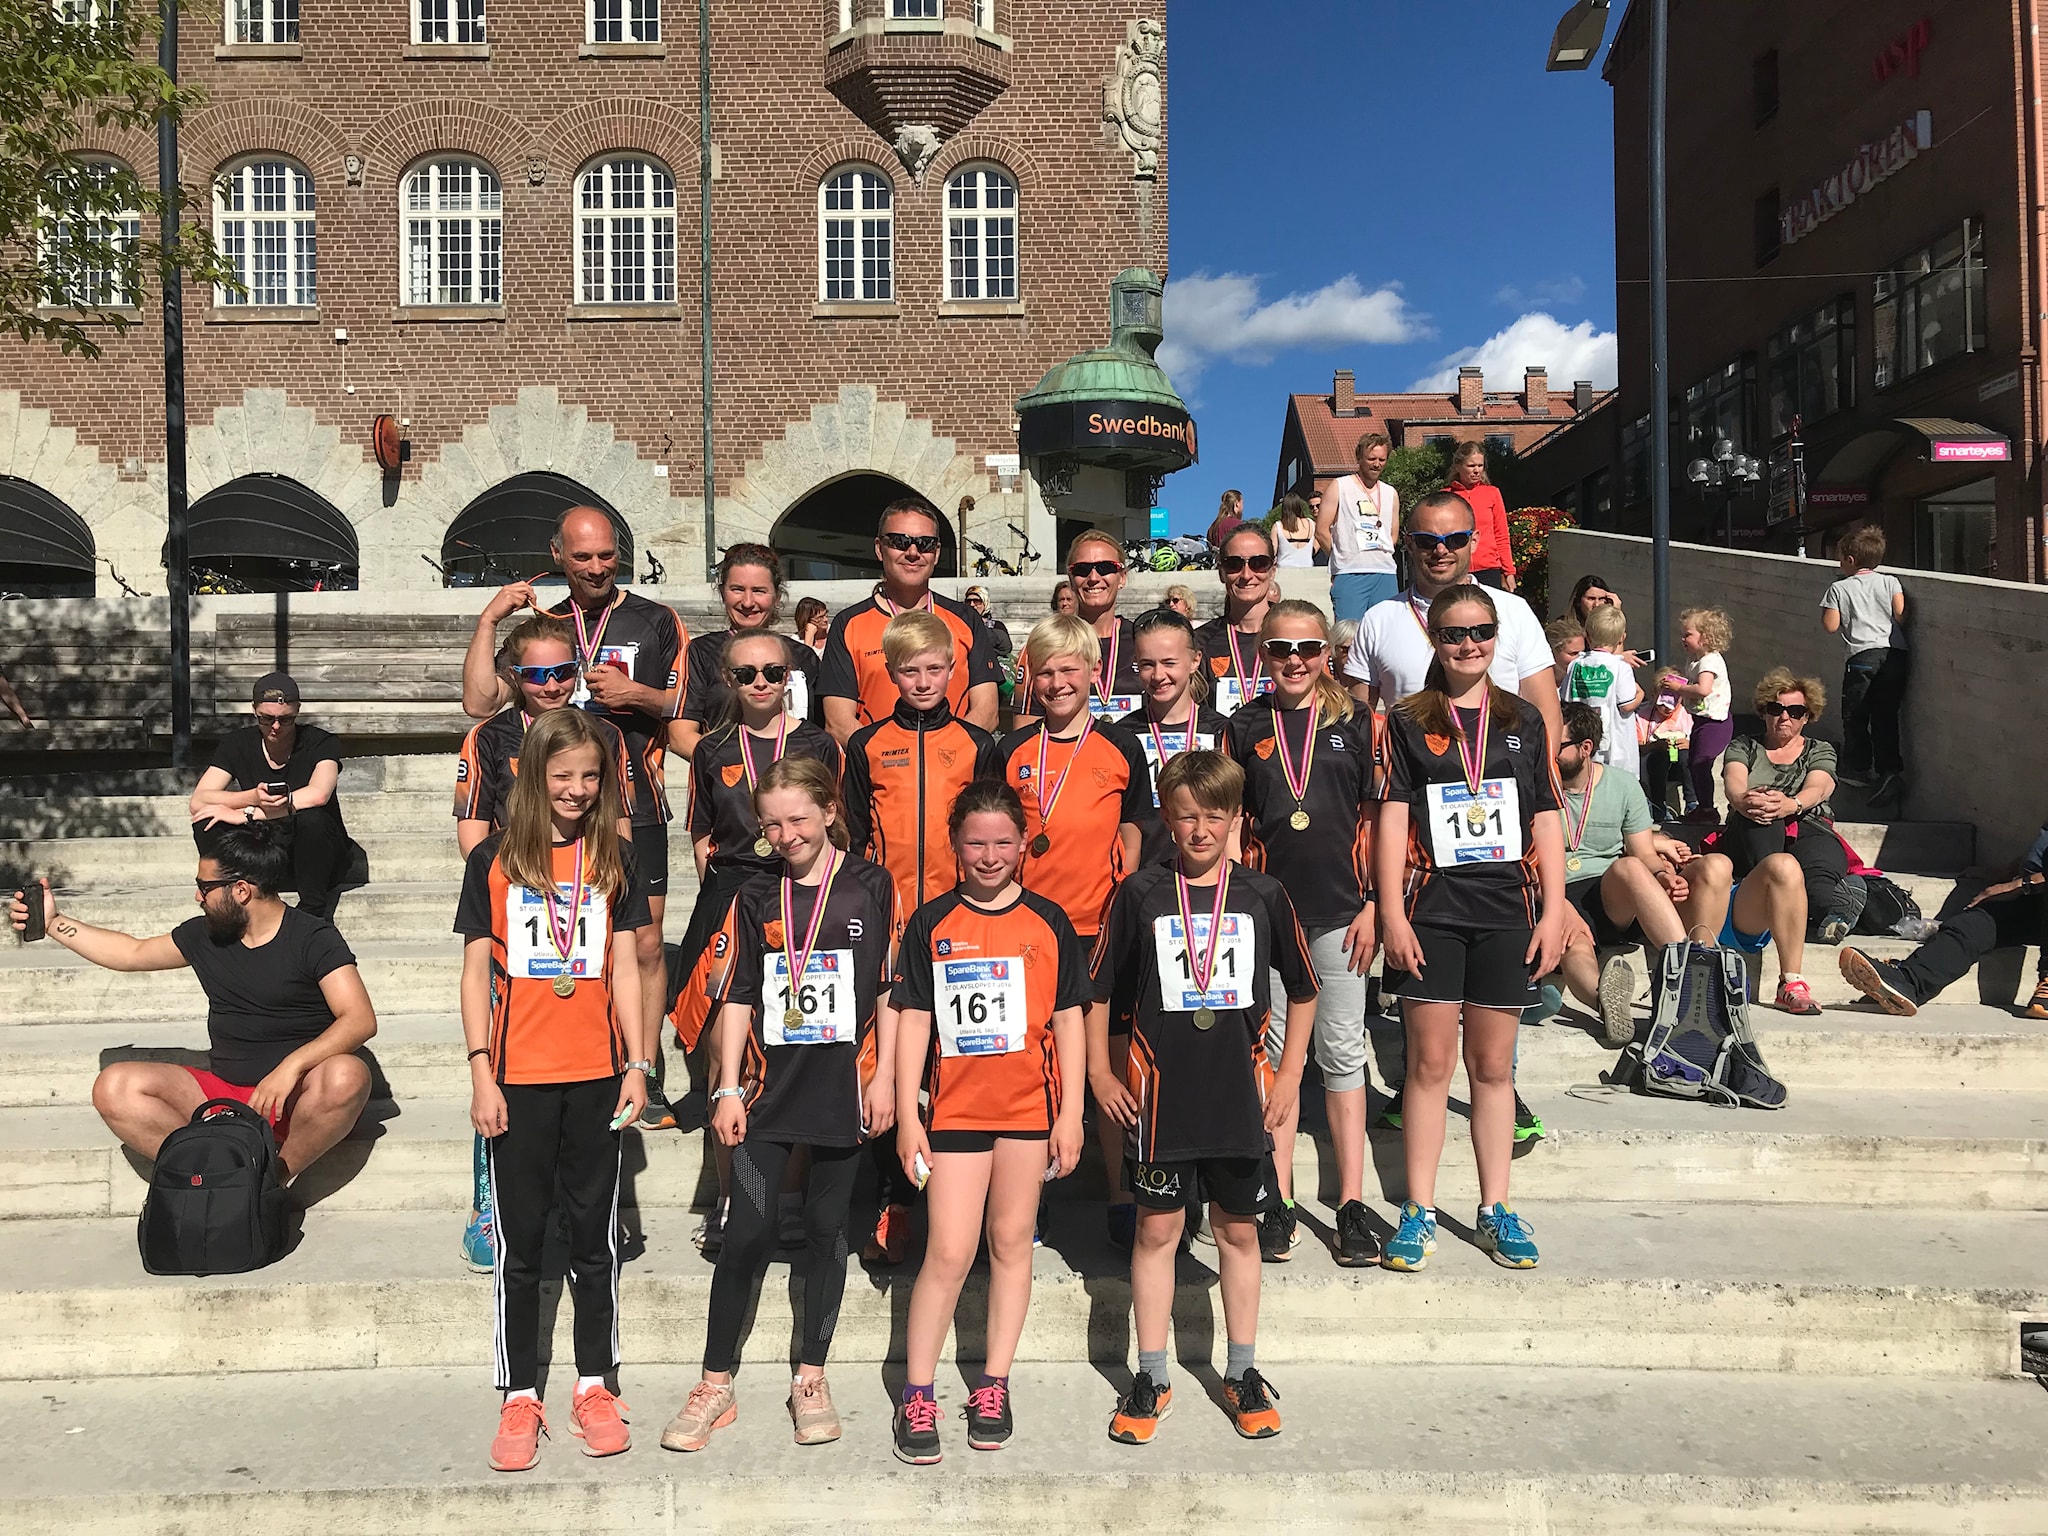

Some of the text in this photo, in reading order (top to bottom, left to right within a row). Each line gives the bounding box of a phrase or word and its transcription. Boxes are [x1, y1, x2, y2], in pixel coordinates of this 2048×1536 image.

[1088, 413, 1186, 442] Swedbank
[1939, 443, 2004, 458] smarteyes
[1811, 492, 1868, 504] smarteyes
[1366, 532, 1379, 541] 37
[881, 747, 910, 757] TRIMTEX
[1445, 786, 1487, 797] Sparek
[948, 964, 991, 976] SpareBank
[778, 983, 835, 1014] 161
[950, 991, 1006, 1025] 161
[958, 1038, 994, 1047] SpareBank
